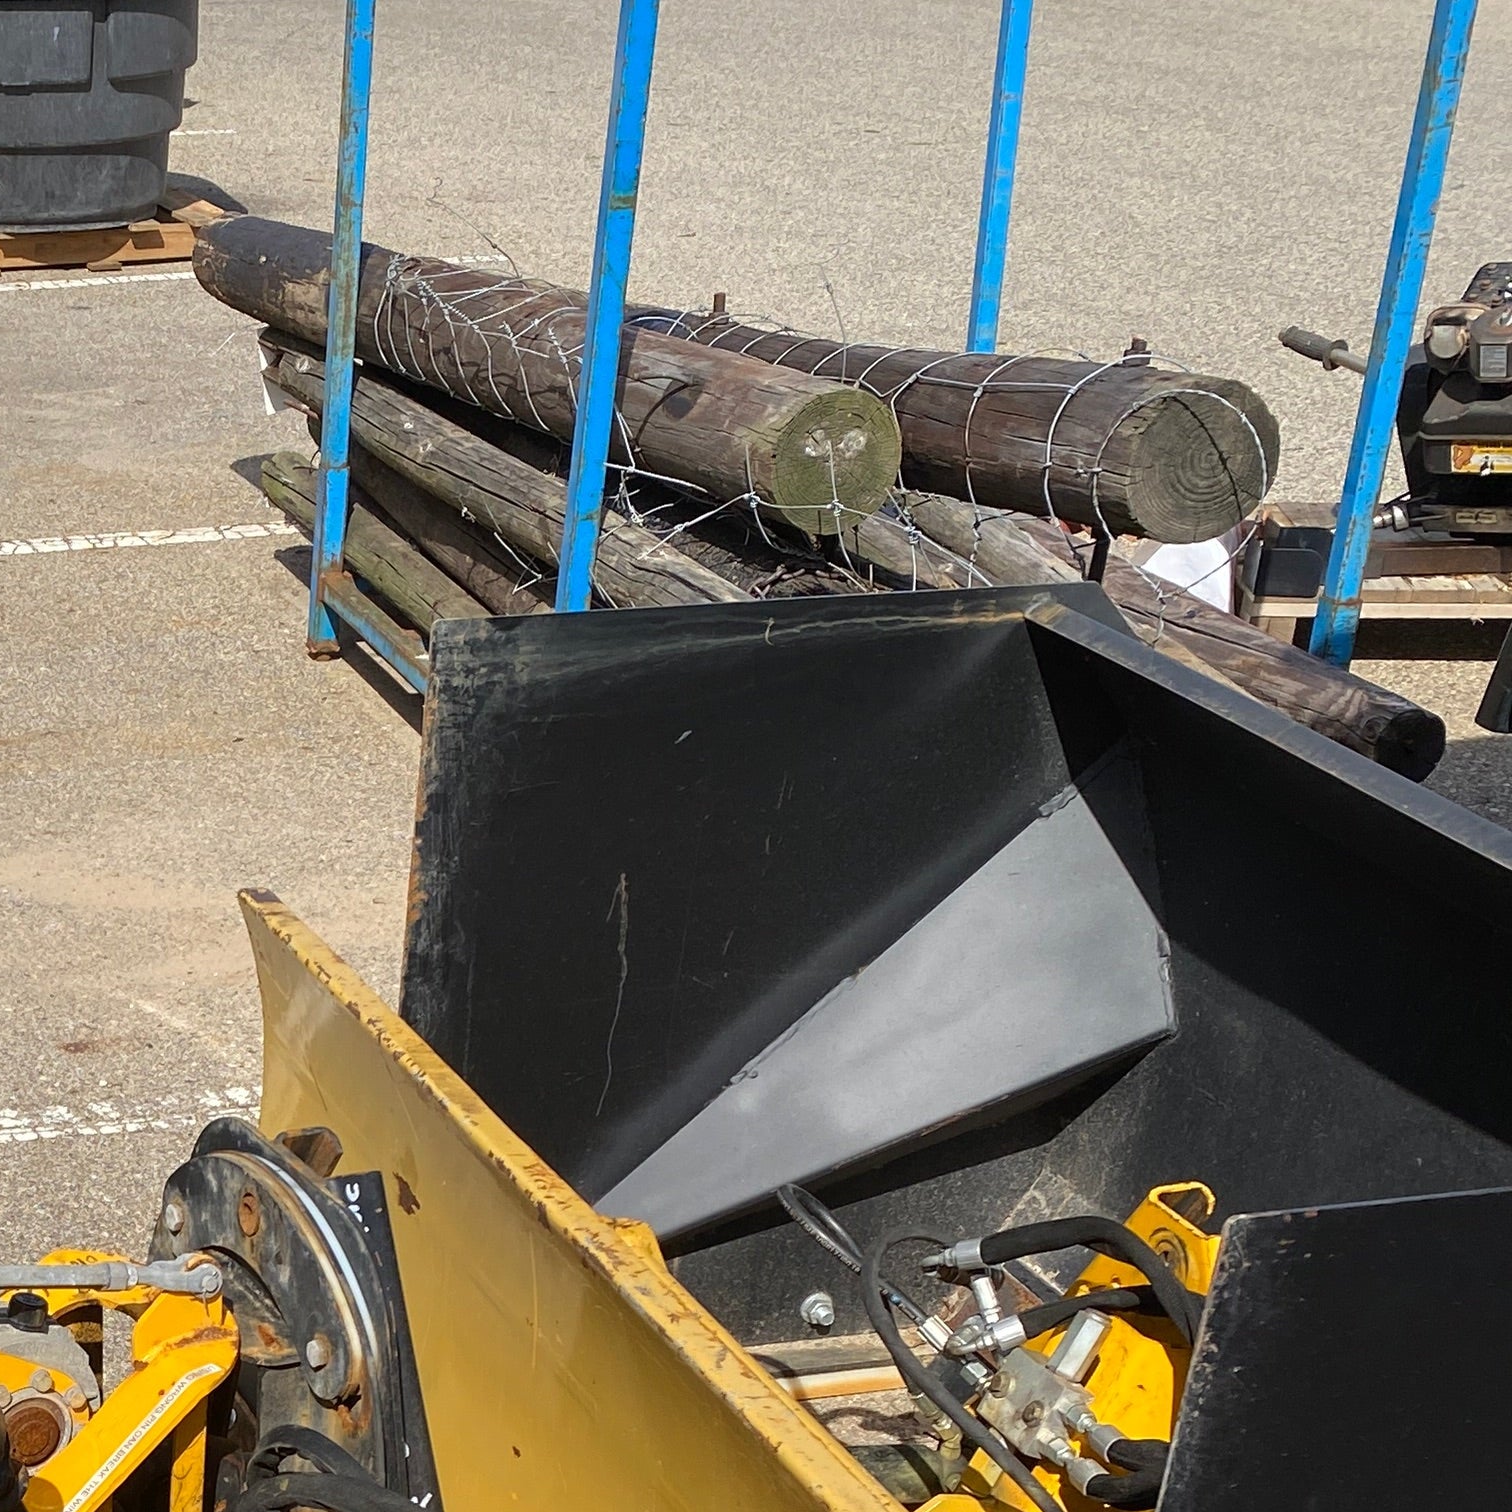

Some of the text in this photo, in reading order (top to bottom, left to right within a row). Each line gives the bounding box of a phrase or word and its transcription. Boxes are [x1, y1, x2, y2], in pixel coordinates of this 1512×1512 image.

[154, 1381, 186, 1413] WRONG
[140, 1413, 155, 1428] PIN
[81, 1480, 98, 1497] THE
